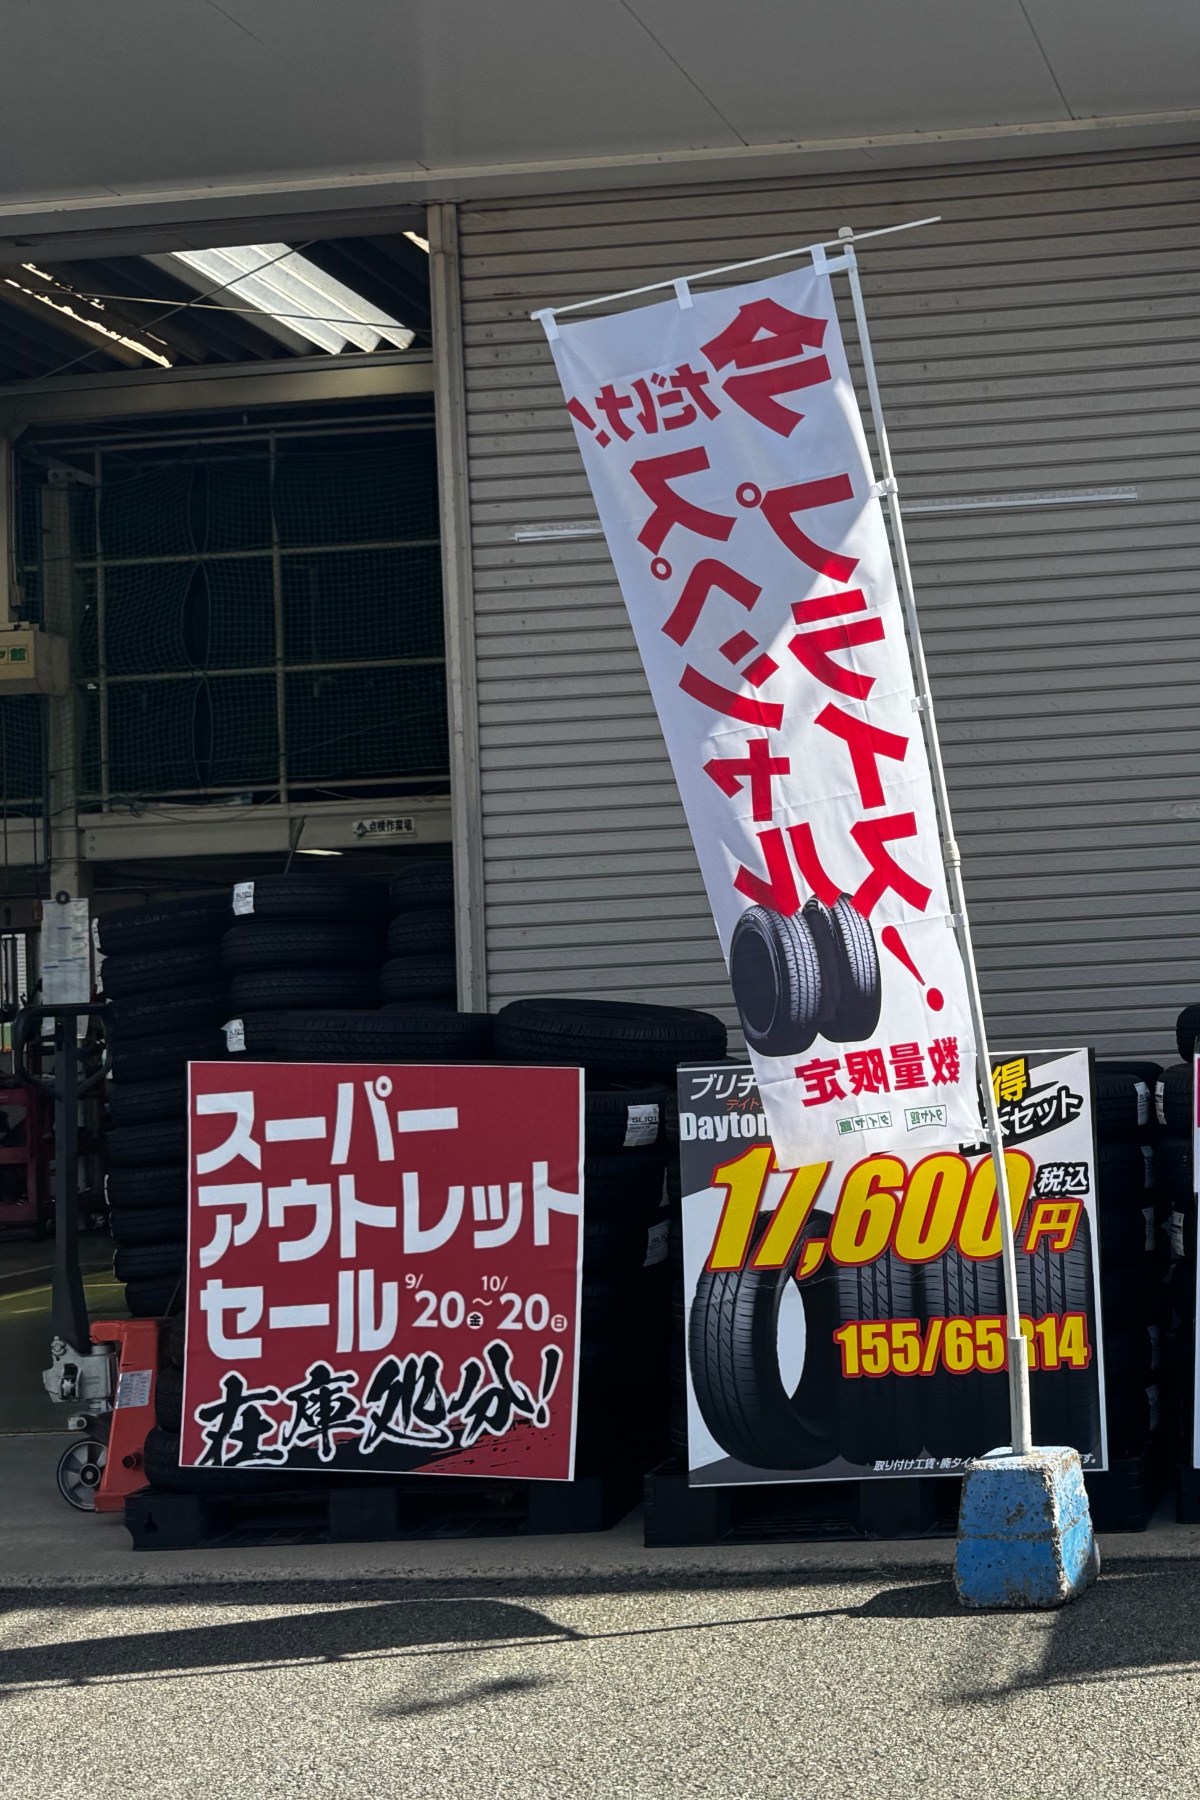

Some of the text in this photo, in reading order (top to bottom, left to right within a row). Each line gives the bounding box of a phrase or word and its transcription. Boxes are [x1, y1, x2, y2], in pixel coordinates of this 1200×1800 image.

[197, 1076, 459, 1175] スーパー
[198, 1161, 585, 1268] アウトレット
[709, 1143, 1088, 1280] 17,600 税込 円
[200, 1268, 399, 1361] セール
[193, 1338, 565, 1466] 在庫処分!
